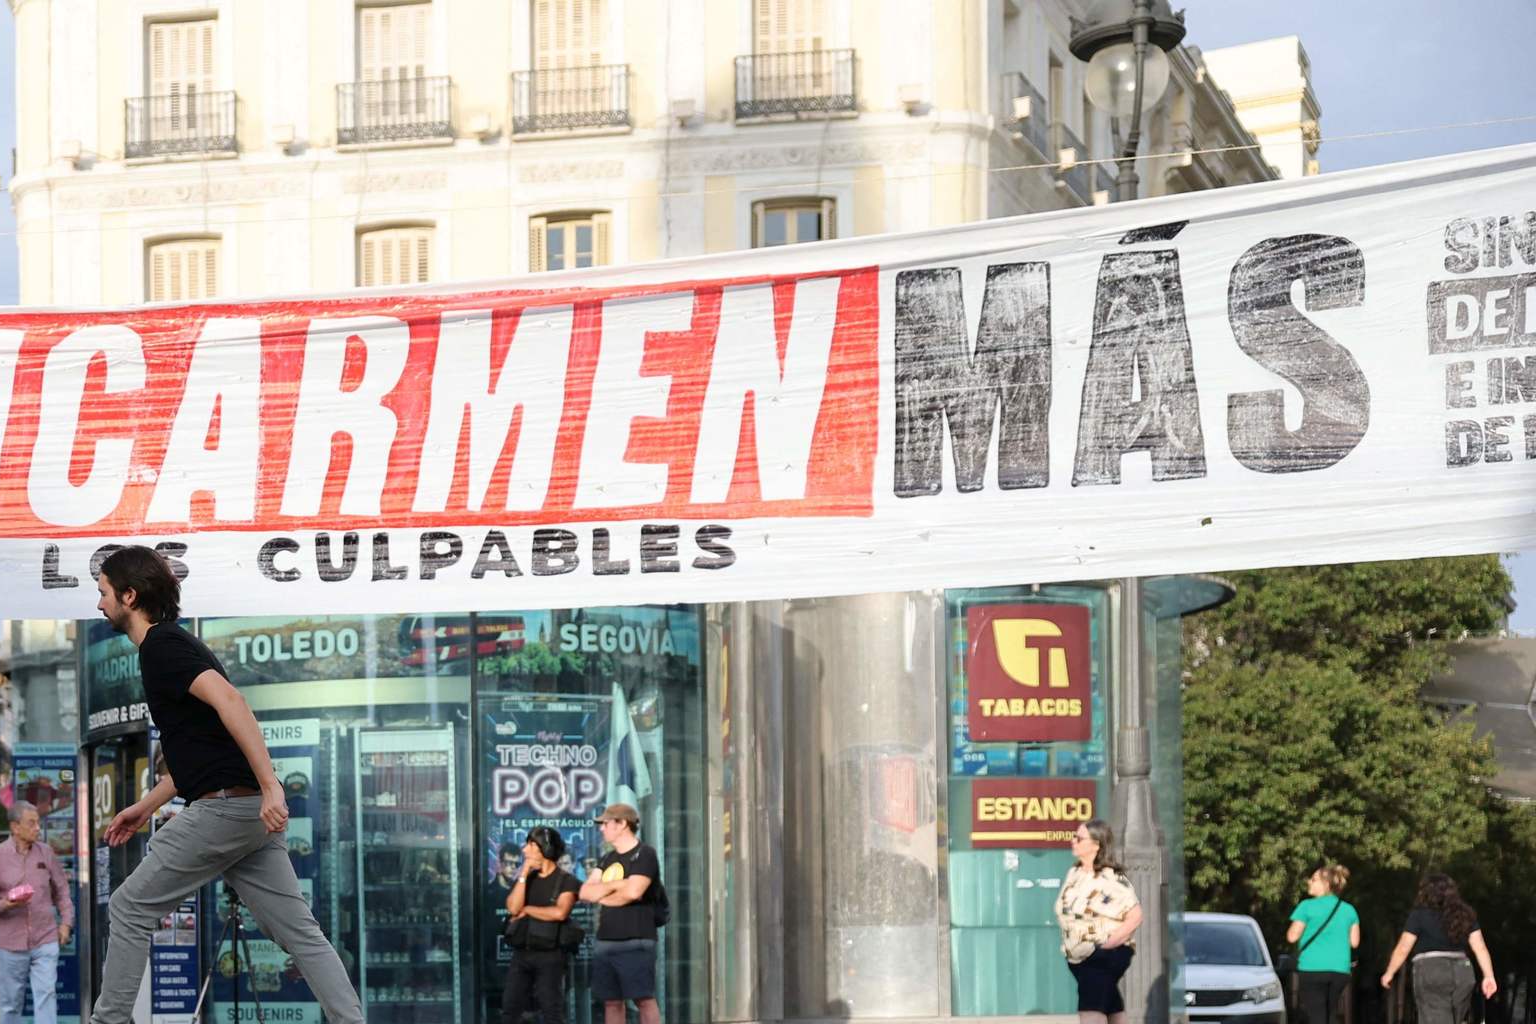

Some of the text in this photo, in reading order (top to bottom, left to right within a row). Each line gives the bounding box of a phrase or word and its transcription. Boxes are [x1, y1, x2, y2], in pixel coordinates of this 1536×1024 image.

[1446, 288, 1510, 340] DE
[894, 220, 1370, 498] MÁS
[1445, 360, 1477, 410] E
[1445, 416, 1515, 468] DE
[257, 524, 737, 583] CULPABLES
[234, 628, 359, 665] TOLEDO
[560, 623, 676, 657] SEGOVIA
[120, 705, 128, 722] &
[979, 698, 1082, 717] TABACOS
[263, 726, 303, 740] ENIRS
[496, 744, 597, 766] TECHNO
[493, 768, 603, 815] POP
[978, 797, 1092, 821] ESTANCO
[505, 817, 594, 828] EL ESPECTÁCULO
